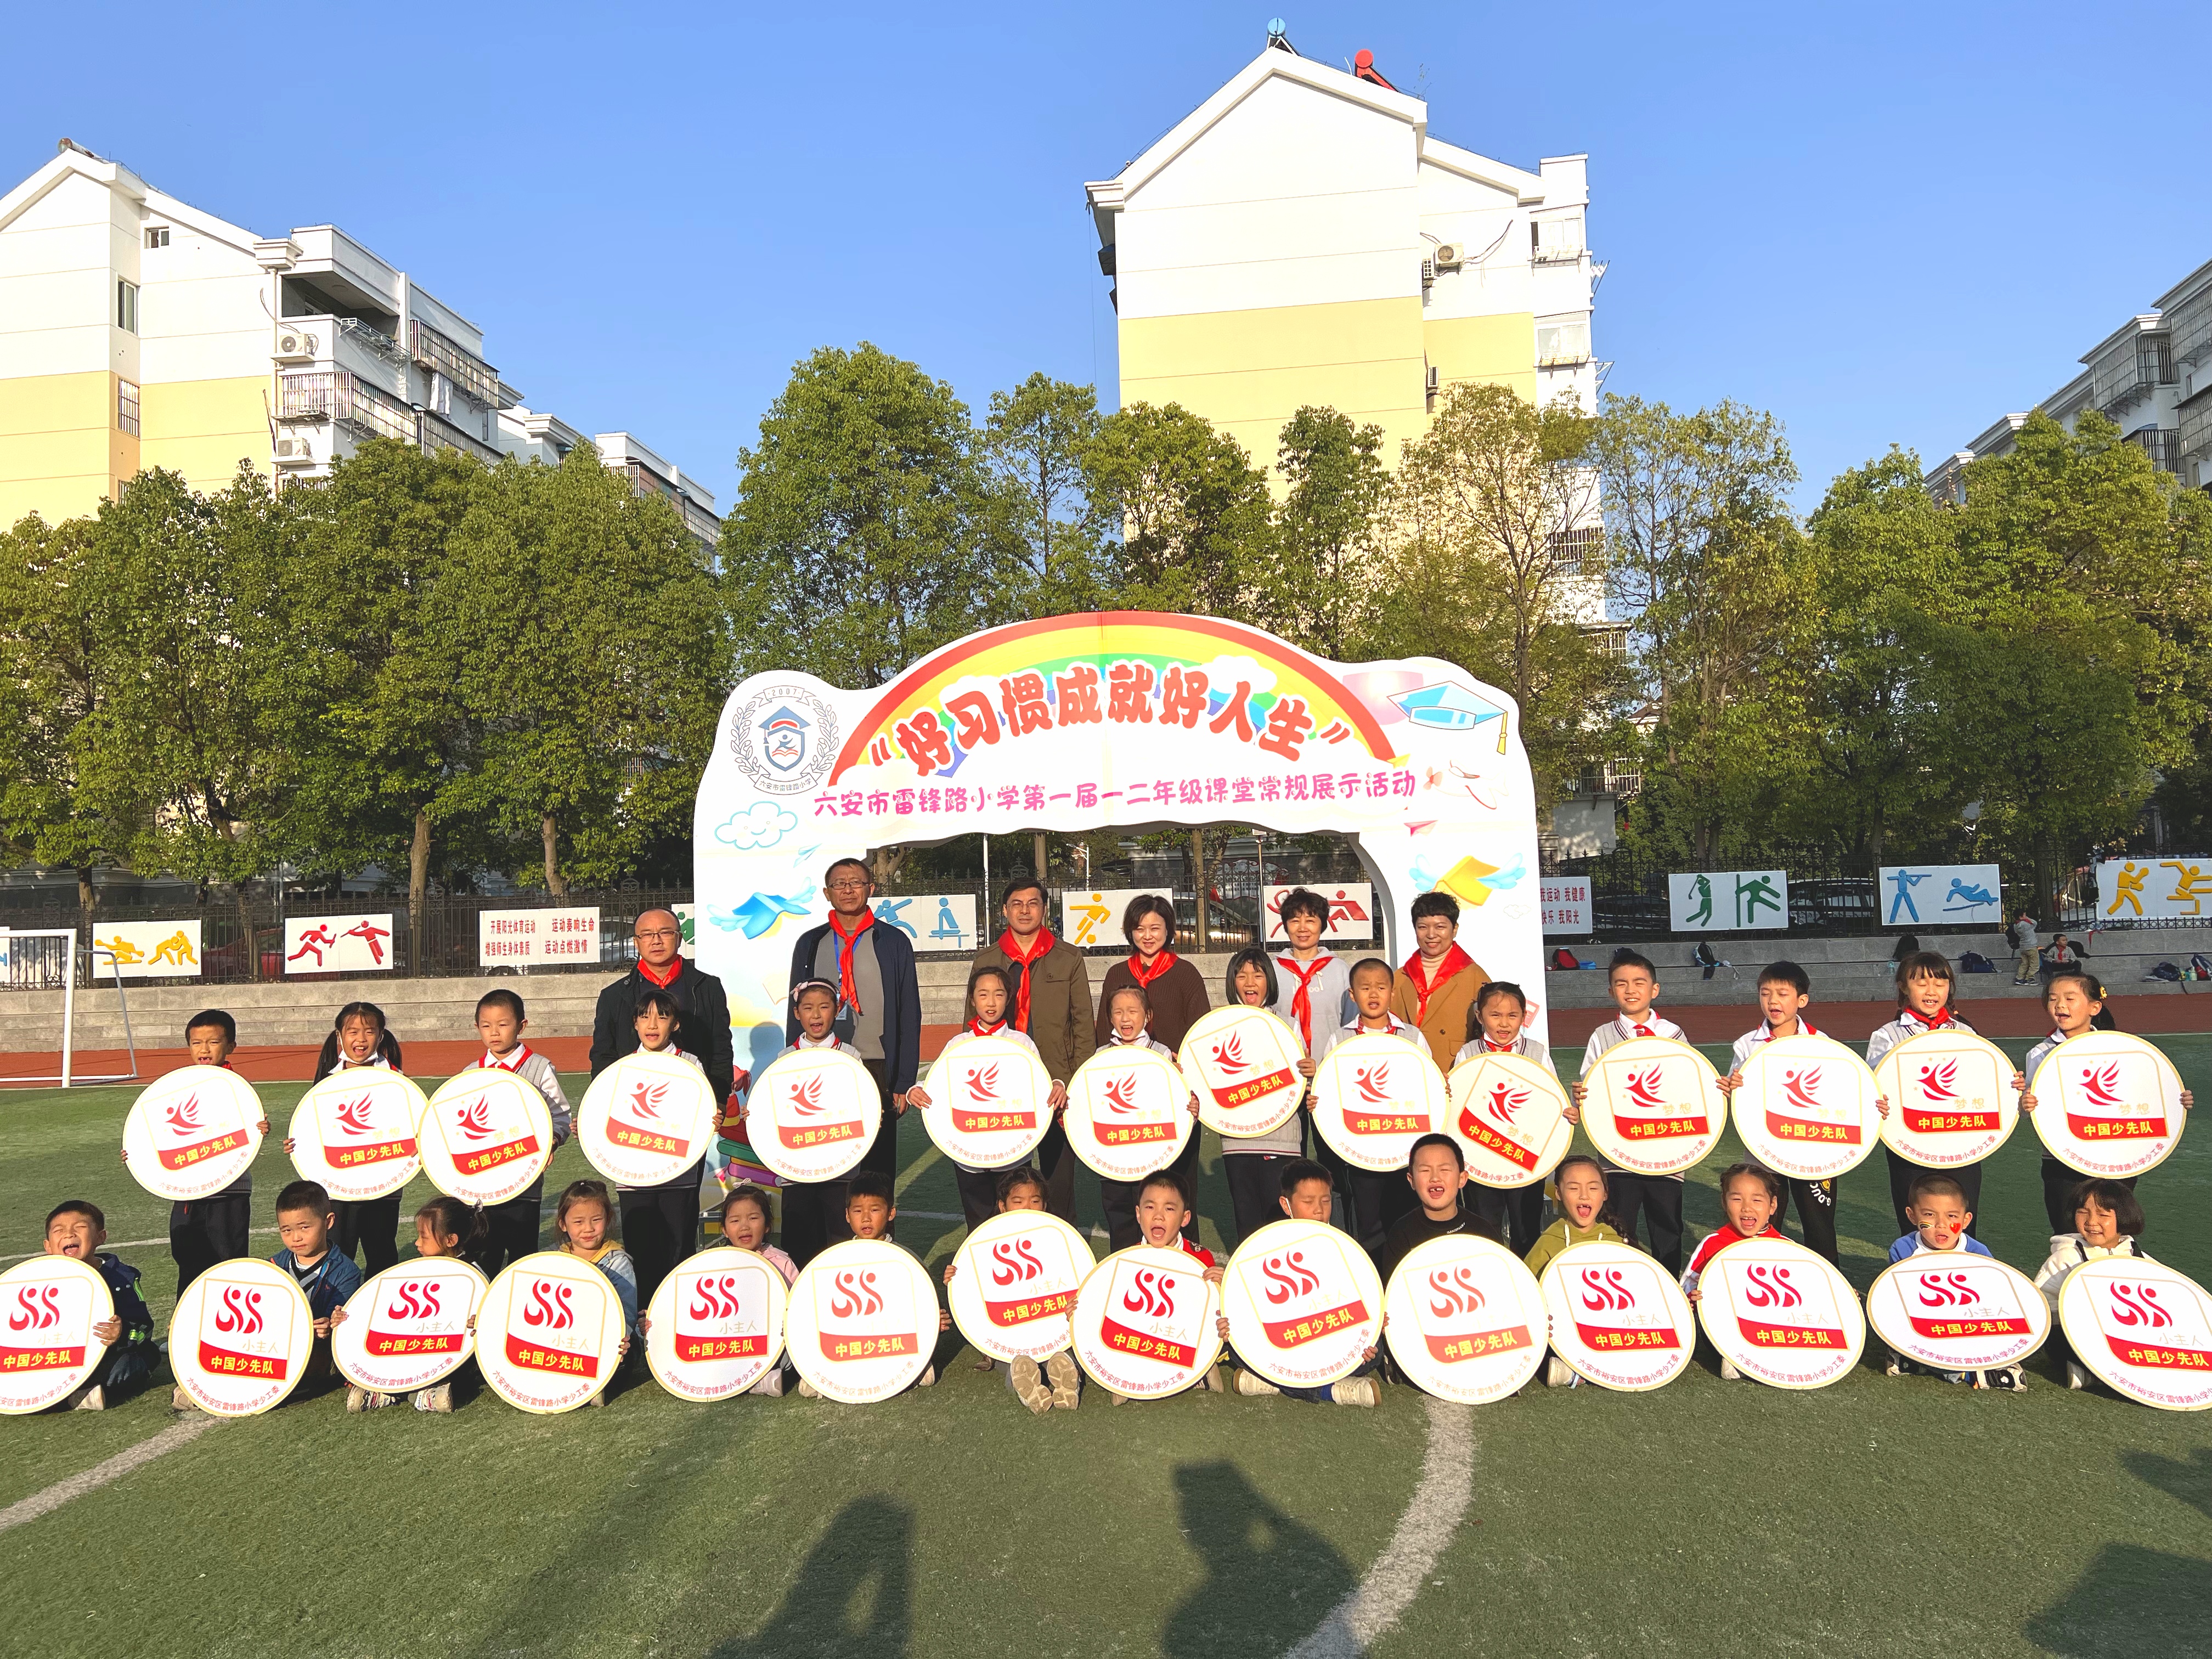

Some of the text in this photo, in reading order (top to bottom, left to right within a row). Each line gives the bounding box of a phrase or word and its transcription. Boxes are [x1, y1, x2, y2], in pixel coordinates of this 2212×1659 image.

[814, 770, 1415, 817] 六安市雷锋路小学第一届一二年级课堂常规展示活动
[1565, 887, 1585, 901] 我健康
[490, 917, 594, 934] 开展阳光体育运动 运动奏响生命
[1559, 910, 1579, 924] 我阳光
[486, 939, 588, 956] 增强师生身体素质 运动点燃激情
[1227, 1075, 1284, 1104] 中国少先队
[965, 1114, 1024, 1129] 中国少先队
[1357, 1117, 1419, 1131] 中国少先队
[1630, 1121, 1696, 1137] 中国少先队
[1918, 1116, 1987, 1130] 中国少先队
[2084, 1122, 2153, 1137] 中国少先队
[792, 1124, 853, 1146] 中国少先队
[1107, 1125, 1165, 1142] 中国少先队
[1780, 1124, 1848, 1140] 中国少先队
[617, 1131, 675, 1153] 中国少先队
[1469, 1125, 1525, 1162] 中国少先队
[174, 1137, 237, 1166] 中国少先队
[340, 1143, 405, 1165] 中国少先队
[468, 1142, 527, 1170] 中国少先队
[1003, 1296, 1068, 1322] 中国少先队
[720, 1322, 757, 1334] 小主人
[1283, 1308, 1355, 1343] 中国少先队
[1931, 1321, 2013, 1335] 中国少先队
[380, 1338, 448, 1352] 中国少先队
[1444, 1331, 1518, 1358] 中国少先队
[1595, 1331, 1666, 1347] 中国少先队
[1757, 1329, 1832, 1344] 中国少先队
[689, 1340, 754, 1357] 中国少先队
[836, 1338, 905, 1357] 中国少先队
[1114, 1333, 1180, 1360] 中国少先队
[4, 1350, 71, 1368] 中国少先队
[211, 1356, 274, 1374] 中国少先队
[519, 1350, 584, 1371] 中国少先队
[2129, 1348, 2210, 1367] 中国少先队
[0, 1373, 77, 1407] 安区雷锋路小学少工委
